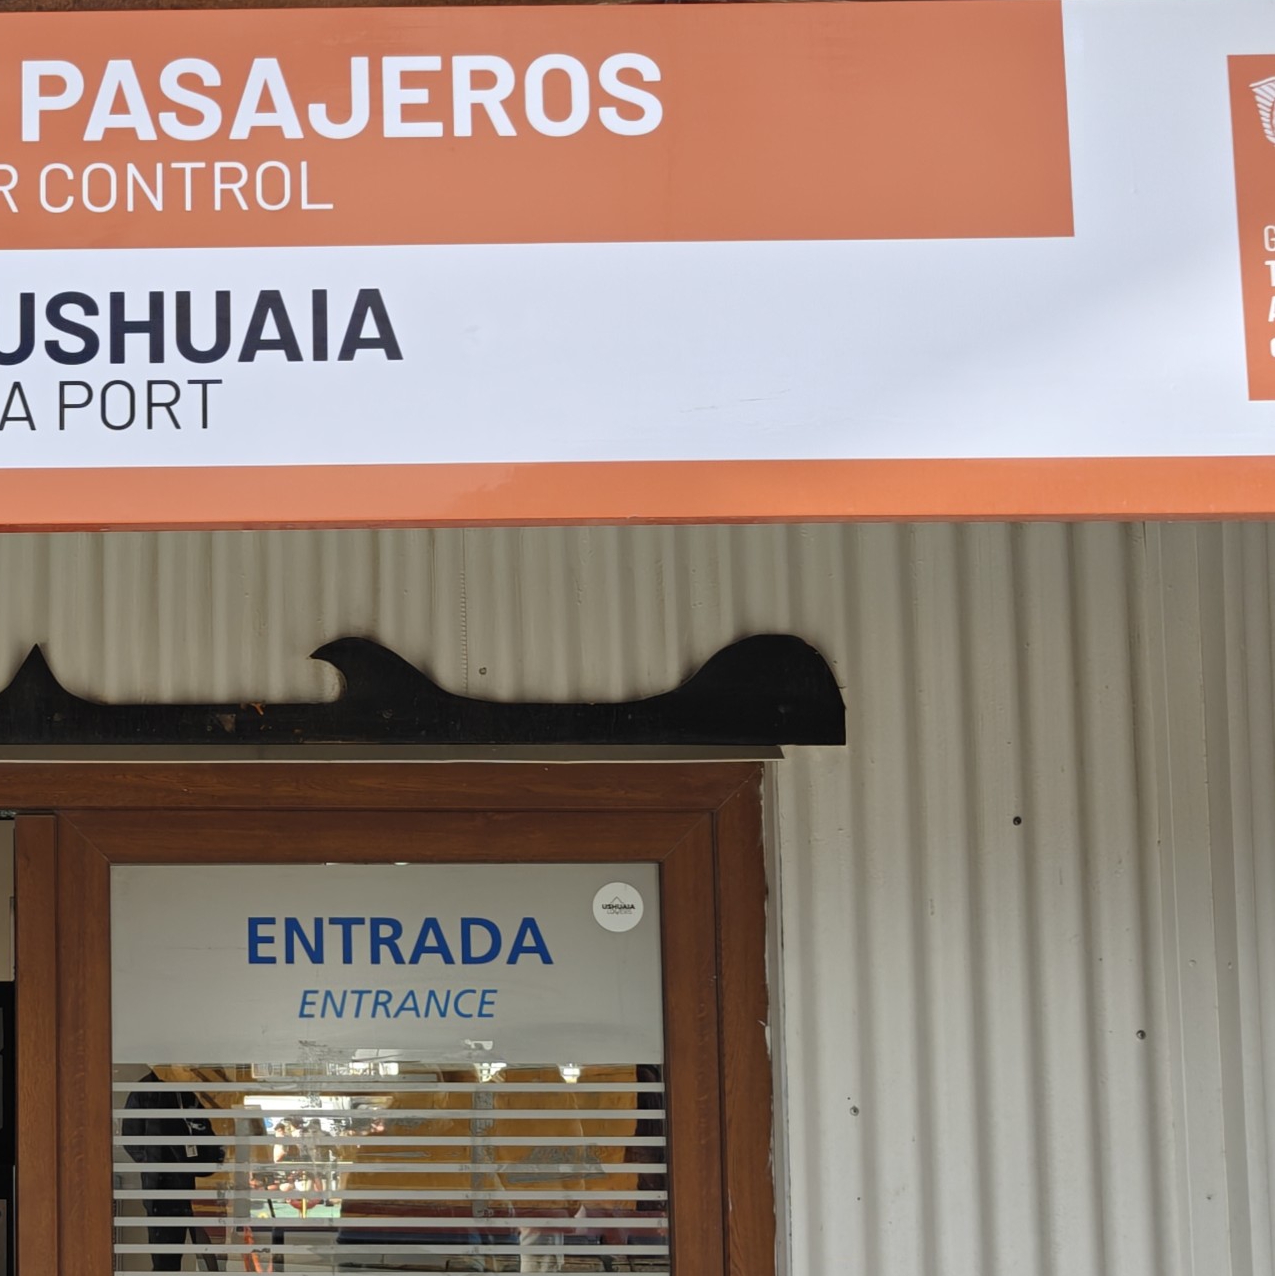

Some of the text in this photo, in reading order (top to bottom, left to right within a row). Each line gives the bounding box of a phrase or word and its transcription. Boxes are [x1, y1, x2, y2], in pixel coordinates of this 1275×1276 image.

[21, 52, 665, 143] PASAJEROS
[39, 159, 335, 214] CONTROL
[58, 379, 224, 431] PORT
[247, 916, 554, 966] ENTRADA
[297, 988, 499, 1020] ENTRANCE
